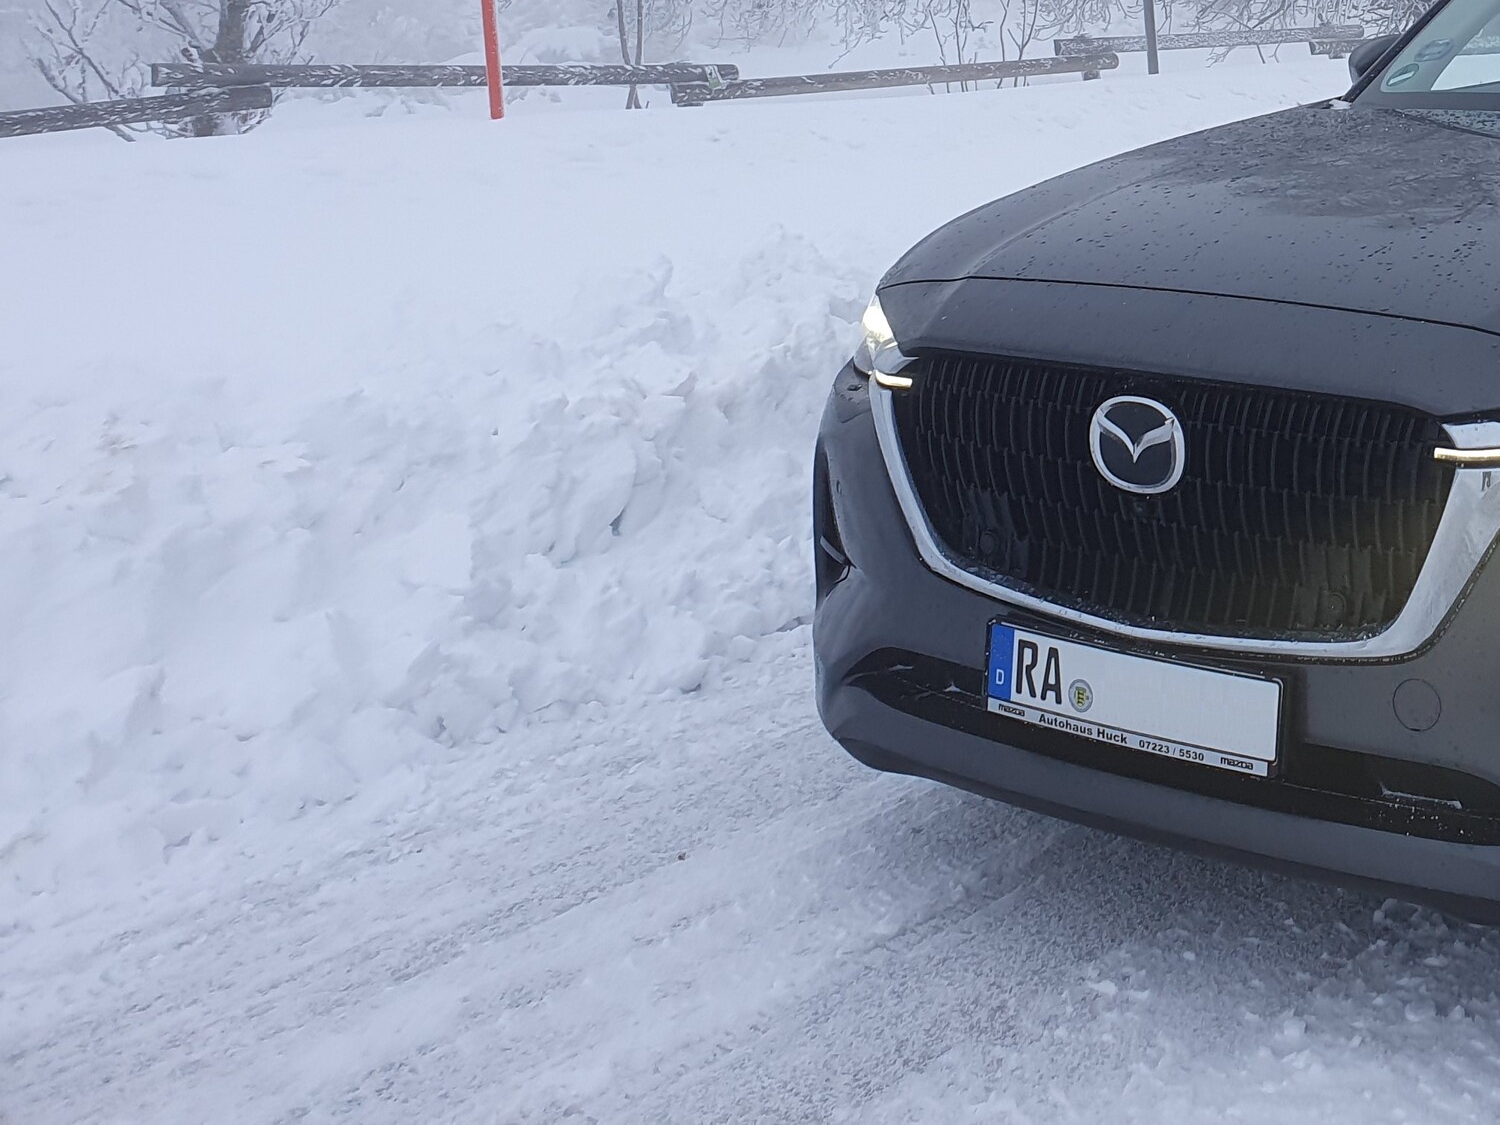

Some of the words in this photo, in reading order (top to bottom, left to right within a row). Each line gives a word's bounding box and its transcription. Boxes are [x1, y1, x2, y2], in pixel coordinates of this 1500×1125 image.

[995, 668, 1005, 686] D
[1015, 639, 1062, 705] RA
[1038, 713, 1093, 737] Autohaus
[1097, 728, 1128, 745] Huck
[1138, 738, 1171, 755] 07223
[1179, 748, 1205, 762] 5530
